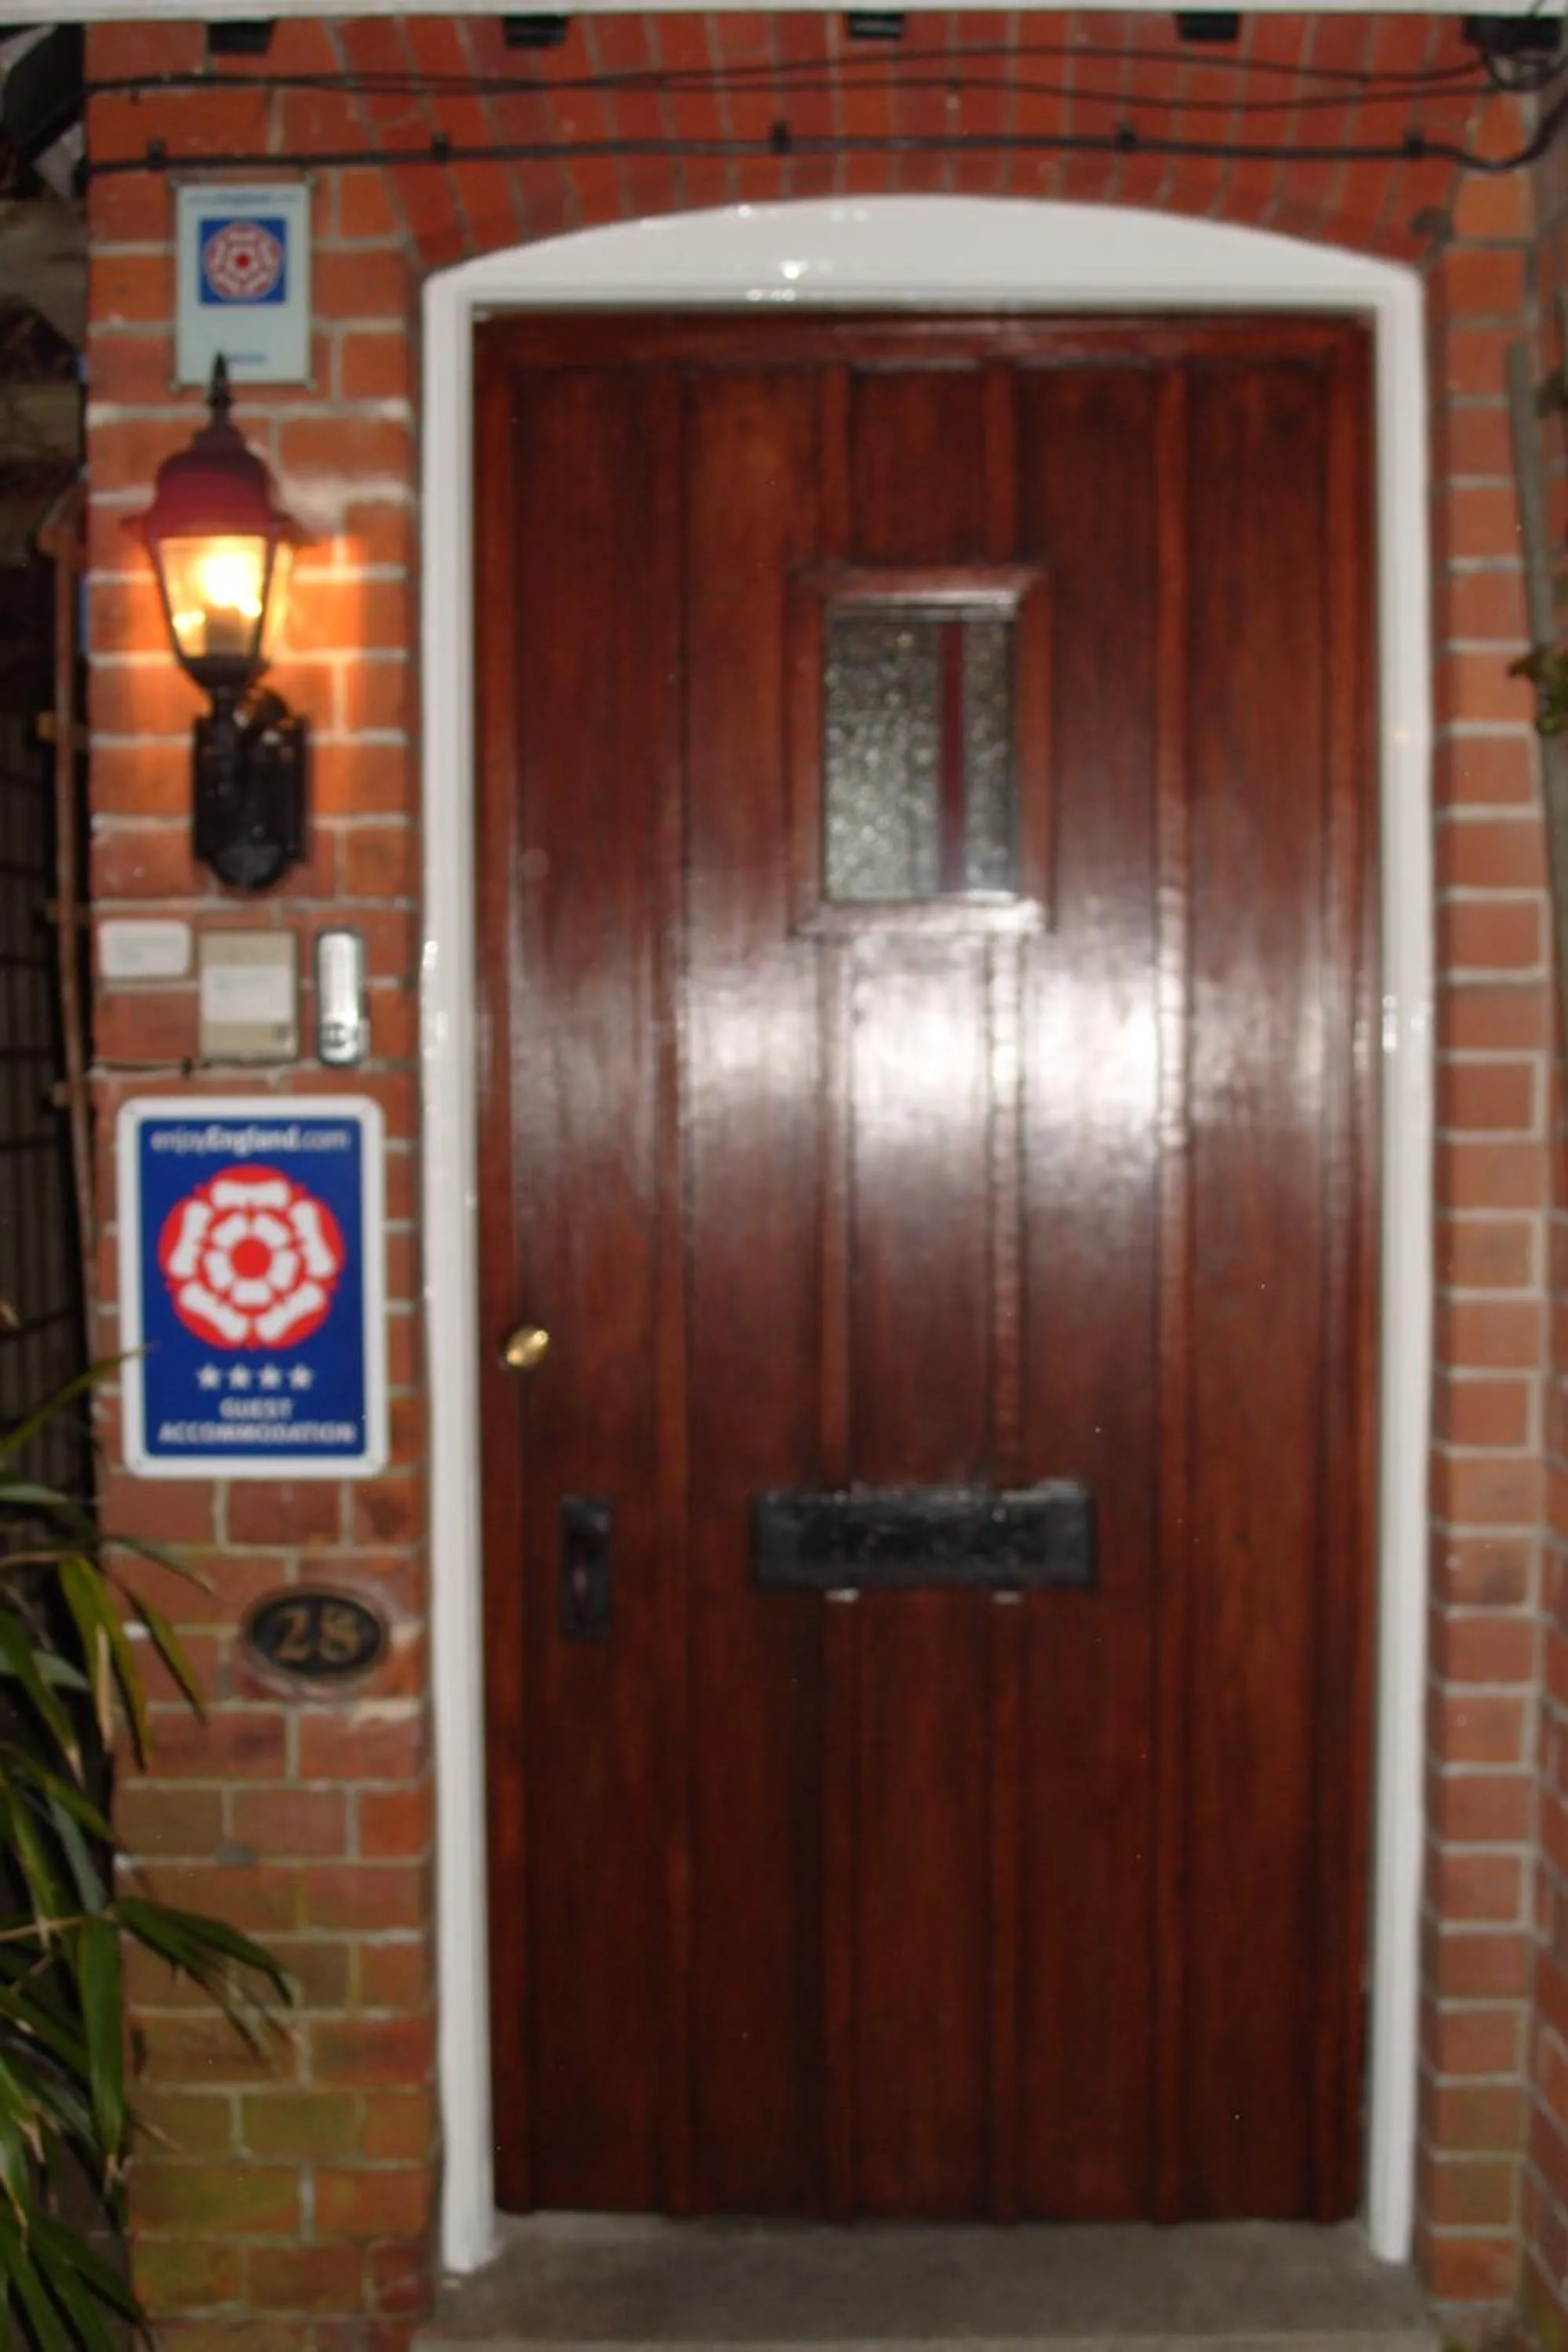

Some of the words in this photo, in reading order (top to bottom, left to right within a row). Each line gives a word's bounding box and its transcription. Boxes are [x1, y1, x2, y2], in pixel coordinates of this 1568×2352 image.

[220, 1397, 294, 1421] GUEST
[158, 1421, 357, 1444] ACCOMMODATION
[274, 1606, 359, 1663] 28
